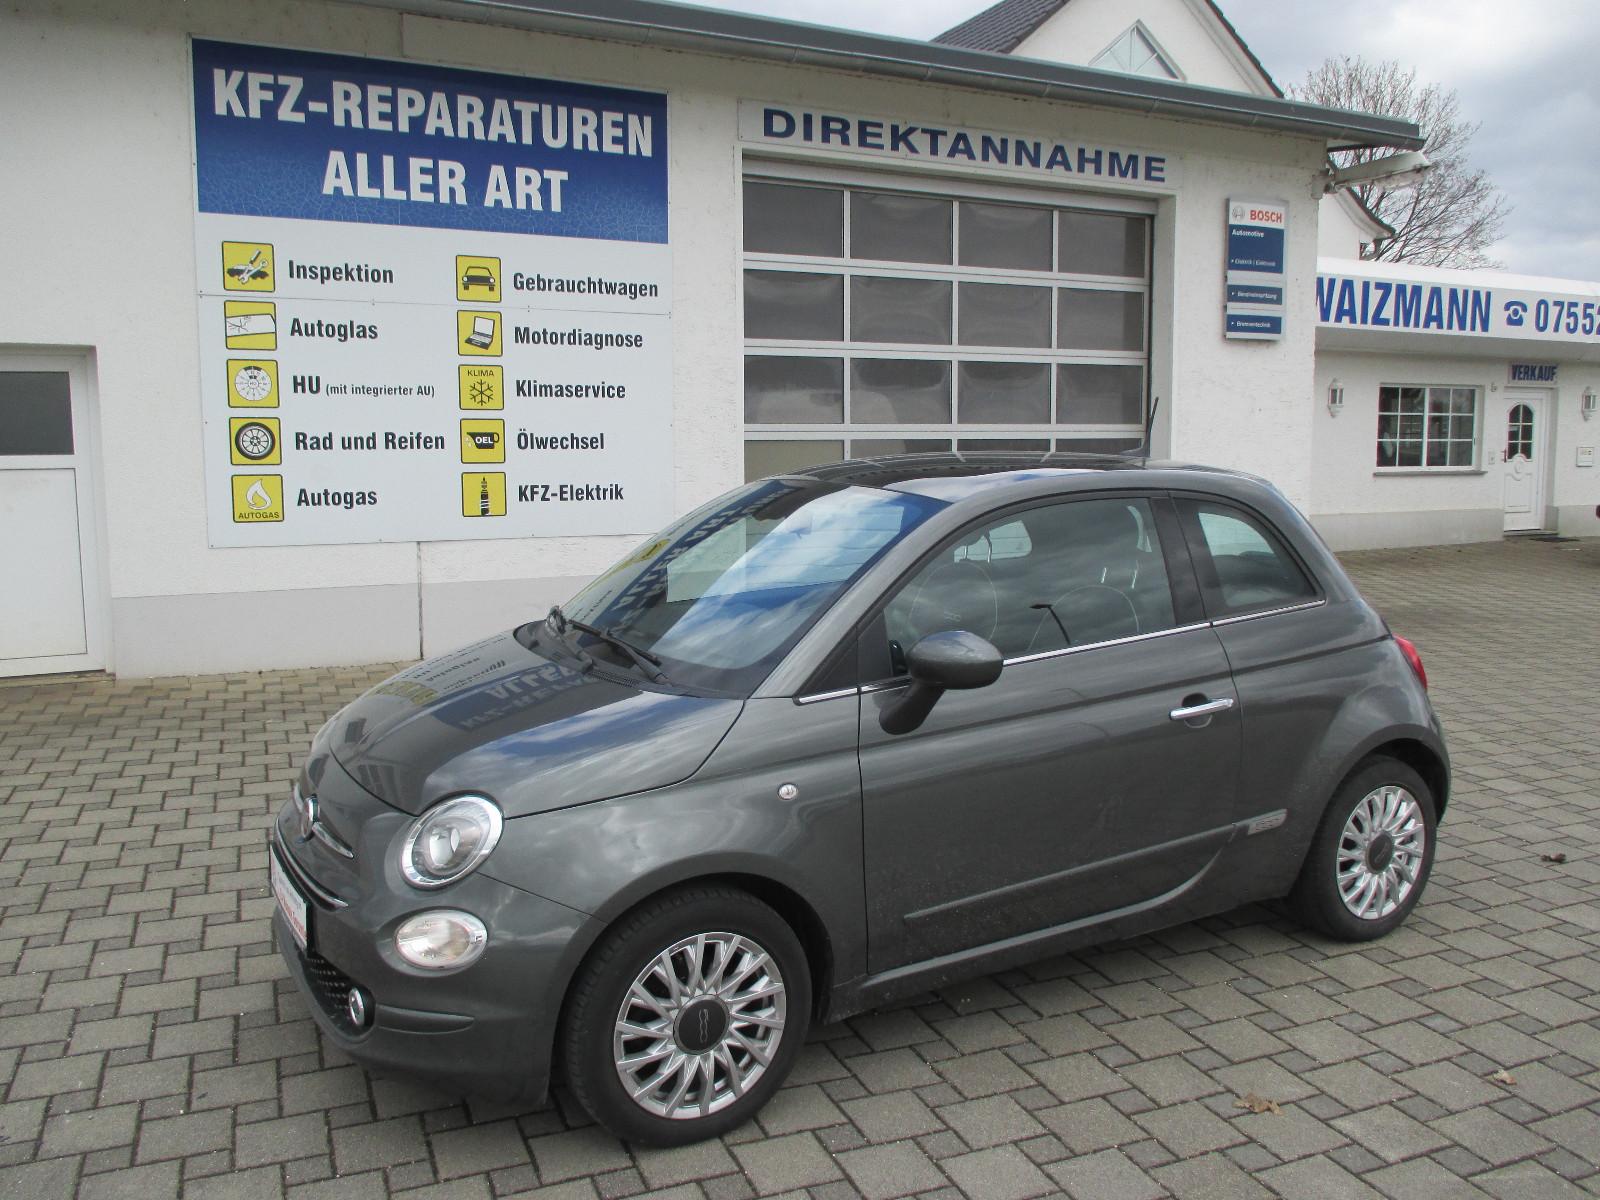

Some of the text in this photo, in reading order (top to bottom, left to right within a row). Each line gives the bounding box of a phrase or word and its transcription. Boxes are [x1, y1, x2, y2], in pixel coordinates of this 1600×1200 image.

[212, 68, 653, 157] KFZ-REPARATUREN
[763, 108, 1166, 183] DIREKTANNAHME
[321, 150, 569, 213] ALLER ART
[1249, 209, 1283, 223] BOSCH
[288, 260, 394, 285] Inspektion
[513, 272, 658, 299] Gebrauchtwagen
[290, 317, 379, 342] Autoglas
[514, 326, 643, 350] Motordiagnose
[467, 369, 495, 377] KLIMA
[1511, 364, 1557, 381] VERKAUF
[292, 375, 435, 398] HU (mit integrierter AU)
[515, 379, 626, 399] Klimaservice
[295, 431, 445, 451] Rad und Reifen
[475, 436, 494, 444] OEL
[517, 428, 605, 450] Ölwechsel
[297, 488, 378, 510] Autogas
[518, 484, 624, 502] KFZ-Elektrik
[238, 511, 280, 520] AUTOGAS
